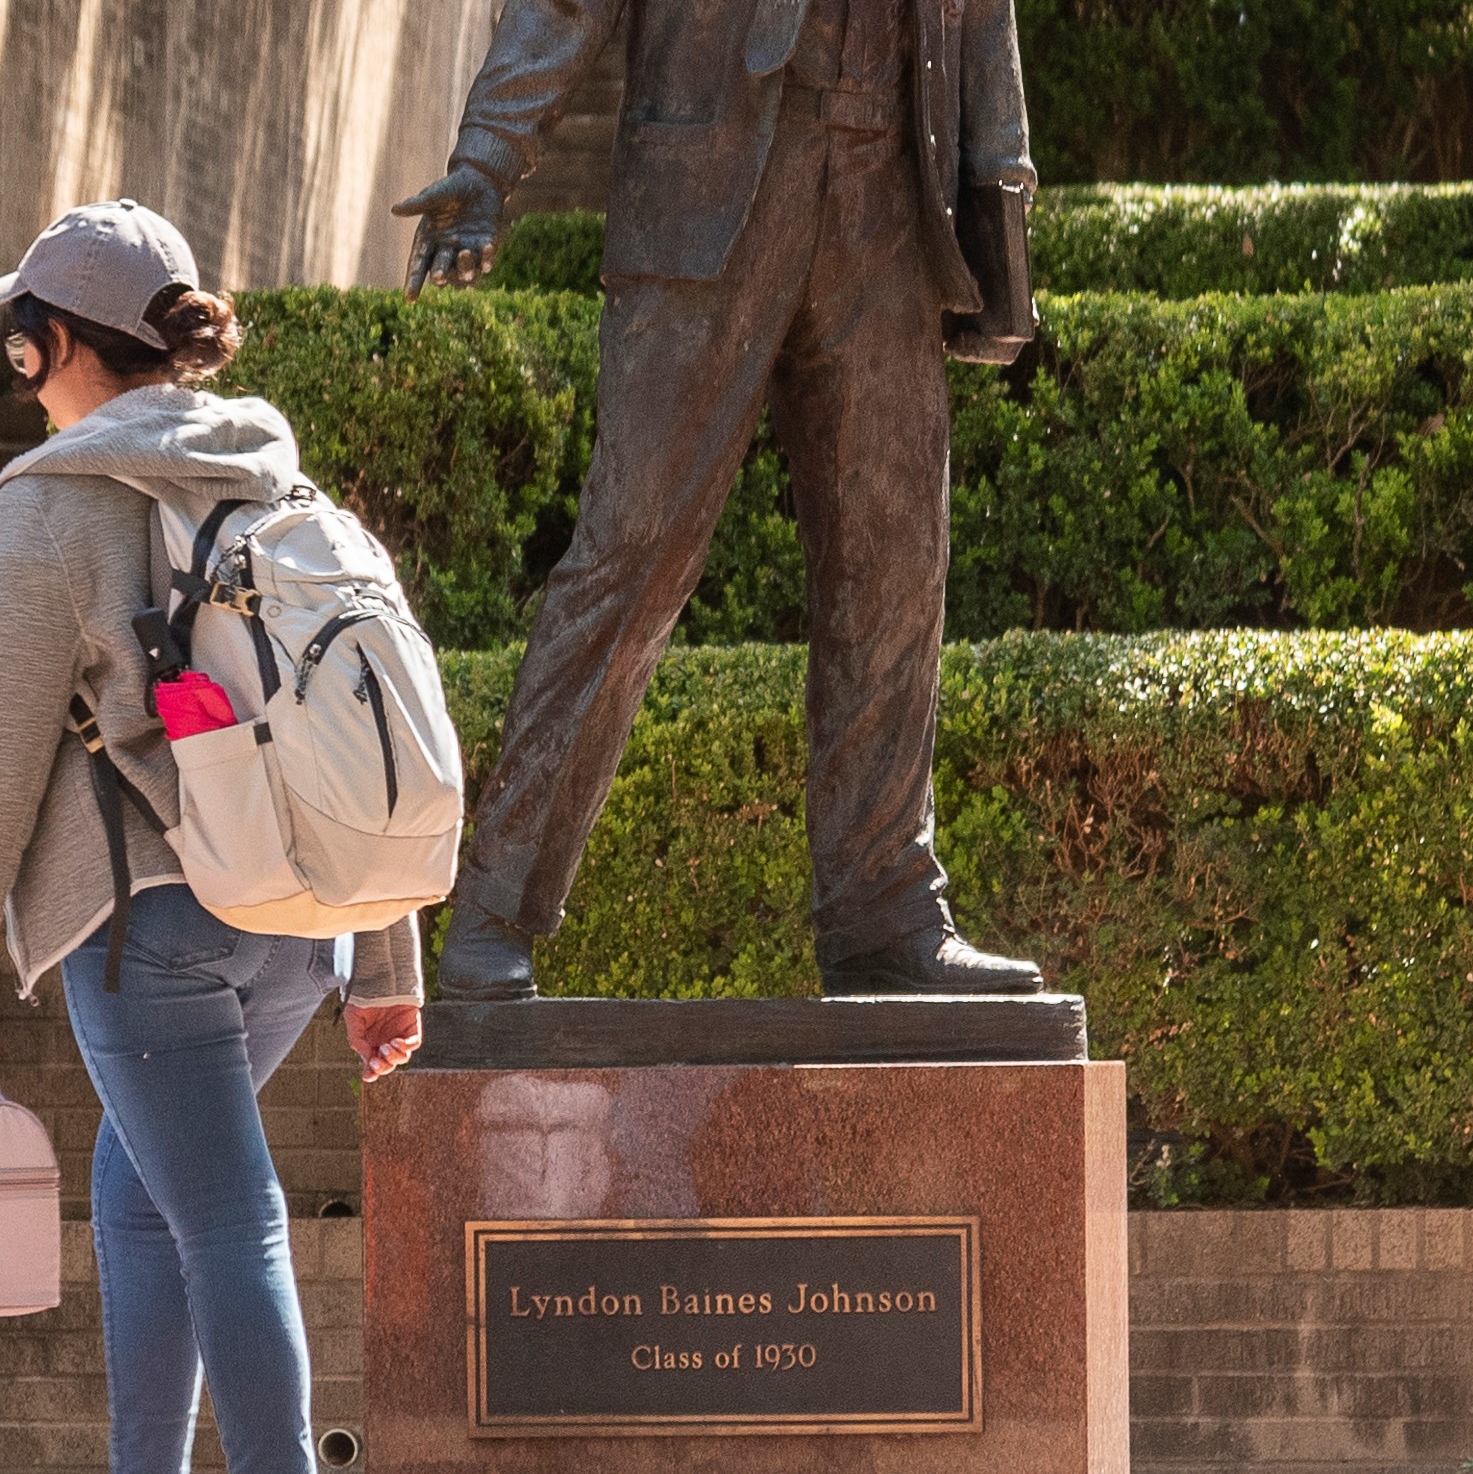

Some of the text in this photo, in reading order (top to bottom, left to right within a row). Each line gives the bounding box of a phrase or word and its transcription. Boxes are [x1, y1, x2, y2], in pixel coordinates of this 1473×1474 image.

[509, 1283, 937, 1320] Lyndon Baines Johnson
[630, 1343, 817, 1371] Class of 1930
